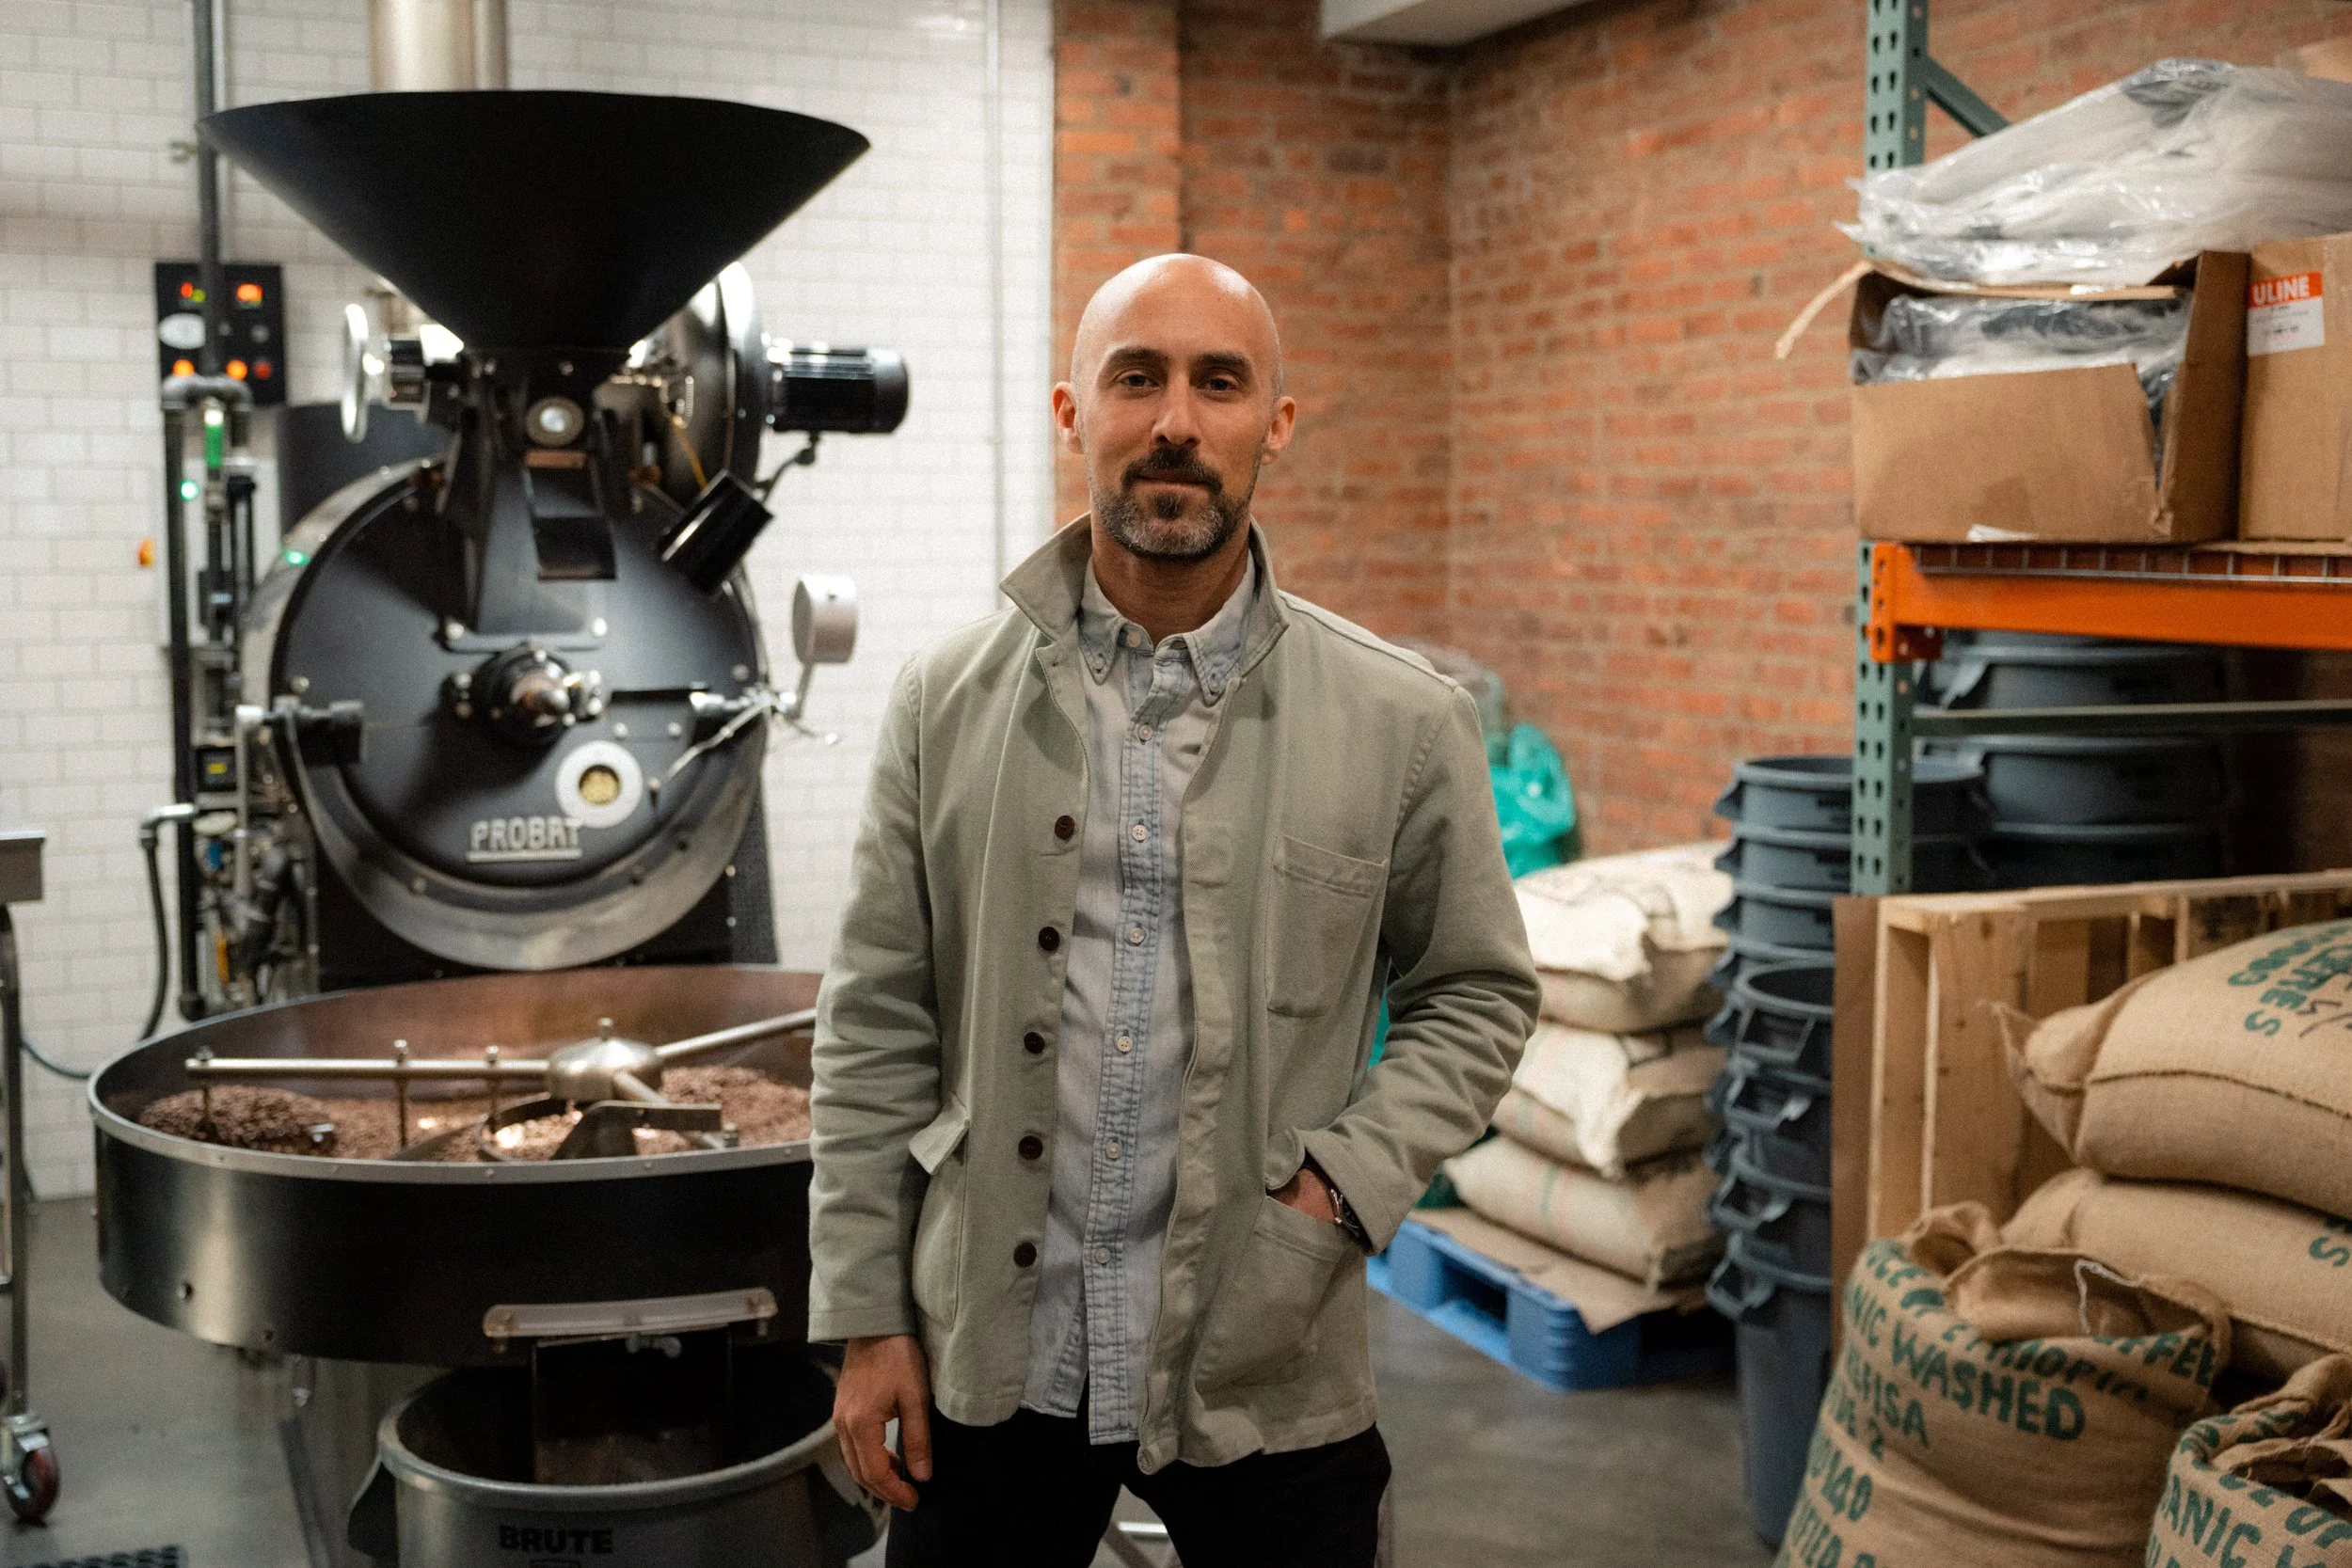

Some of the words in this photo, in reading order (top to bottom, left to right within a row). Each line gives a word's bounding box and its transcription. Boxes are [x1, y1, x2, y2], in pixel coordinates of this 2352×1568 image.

[2252, 275, 2310, 306] ULINE
[471, 816, 581, 851] PROBAT
[1892, 1320, 2087, 1442] WASHED
[499, 1525, 613, 1554] BRUTE
